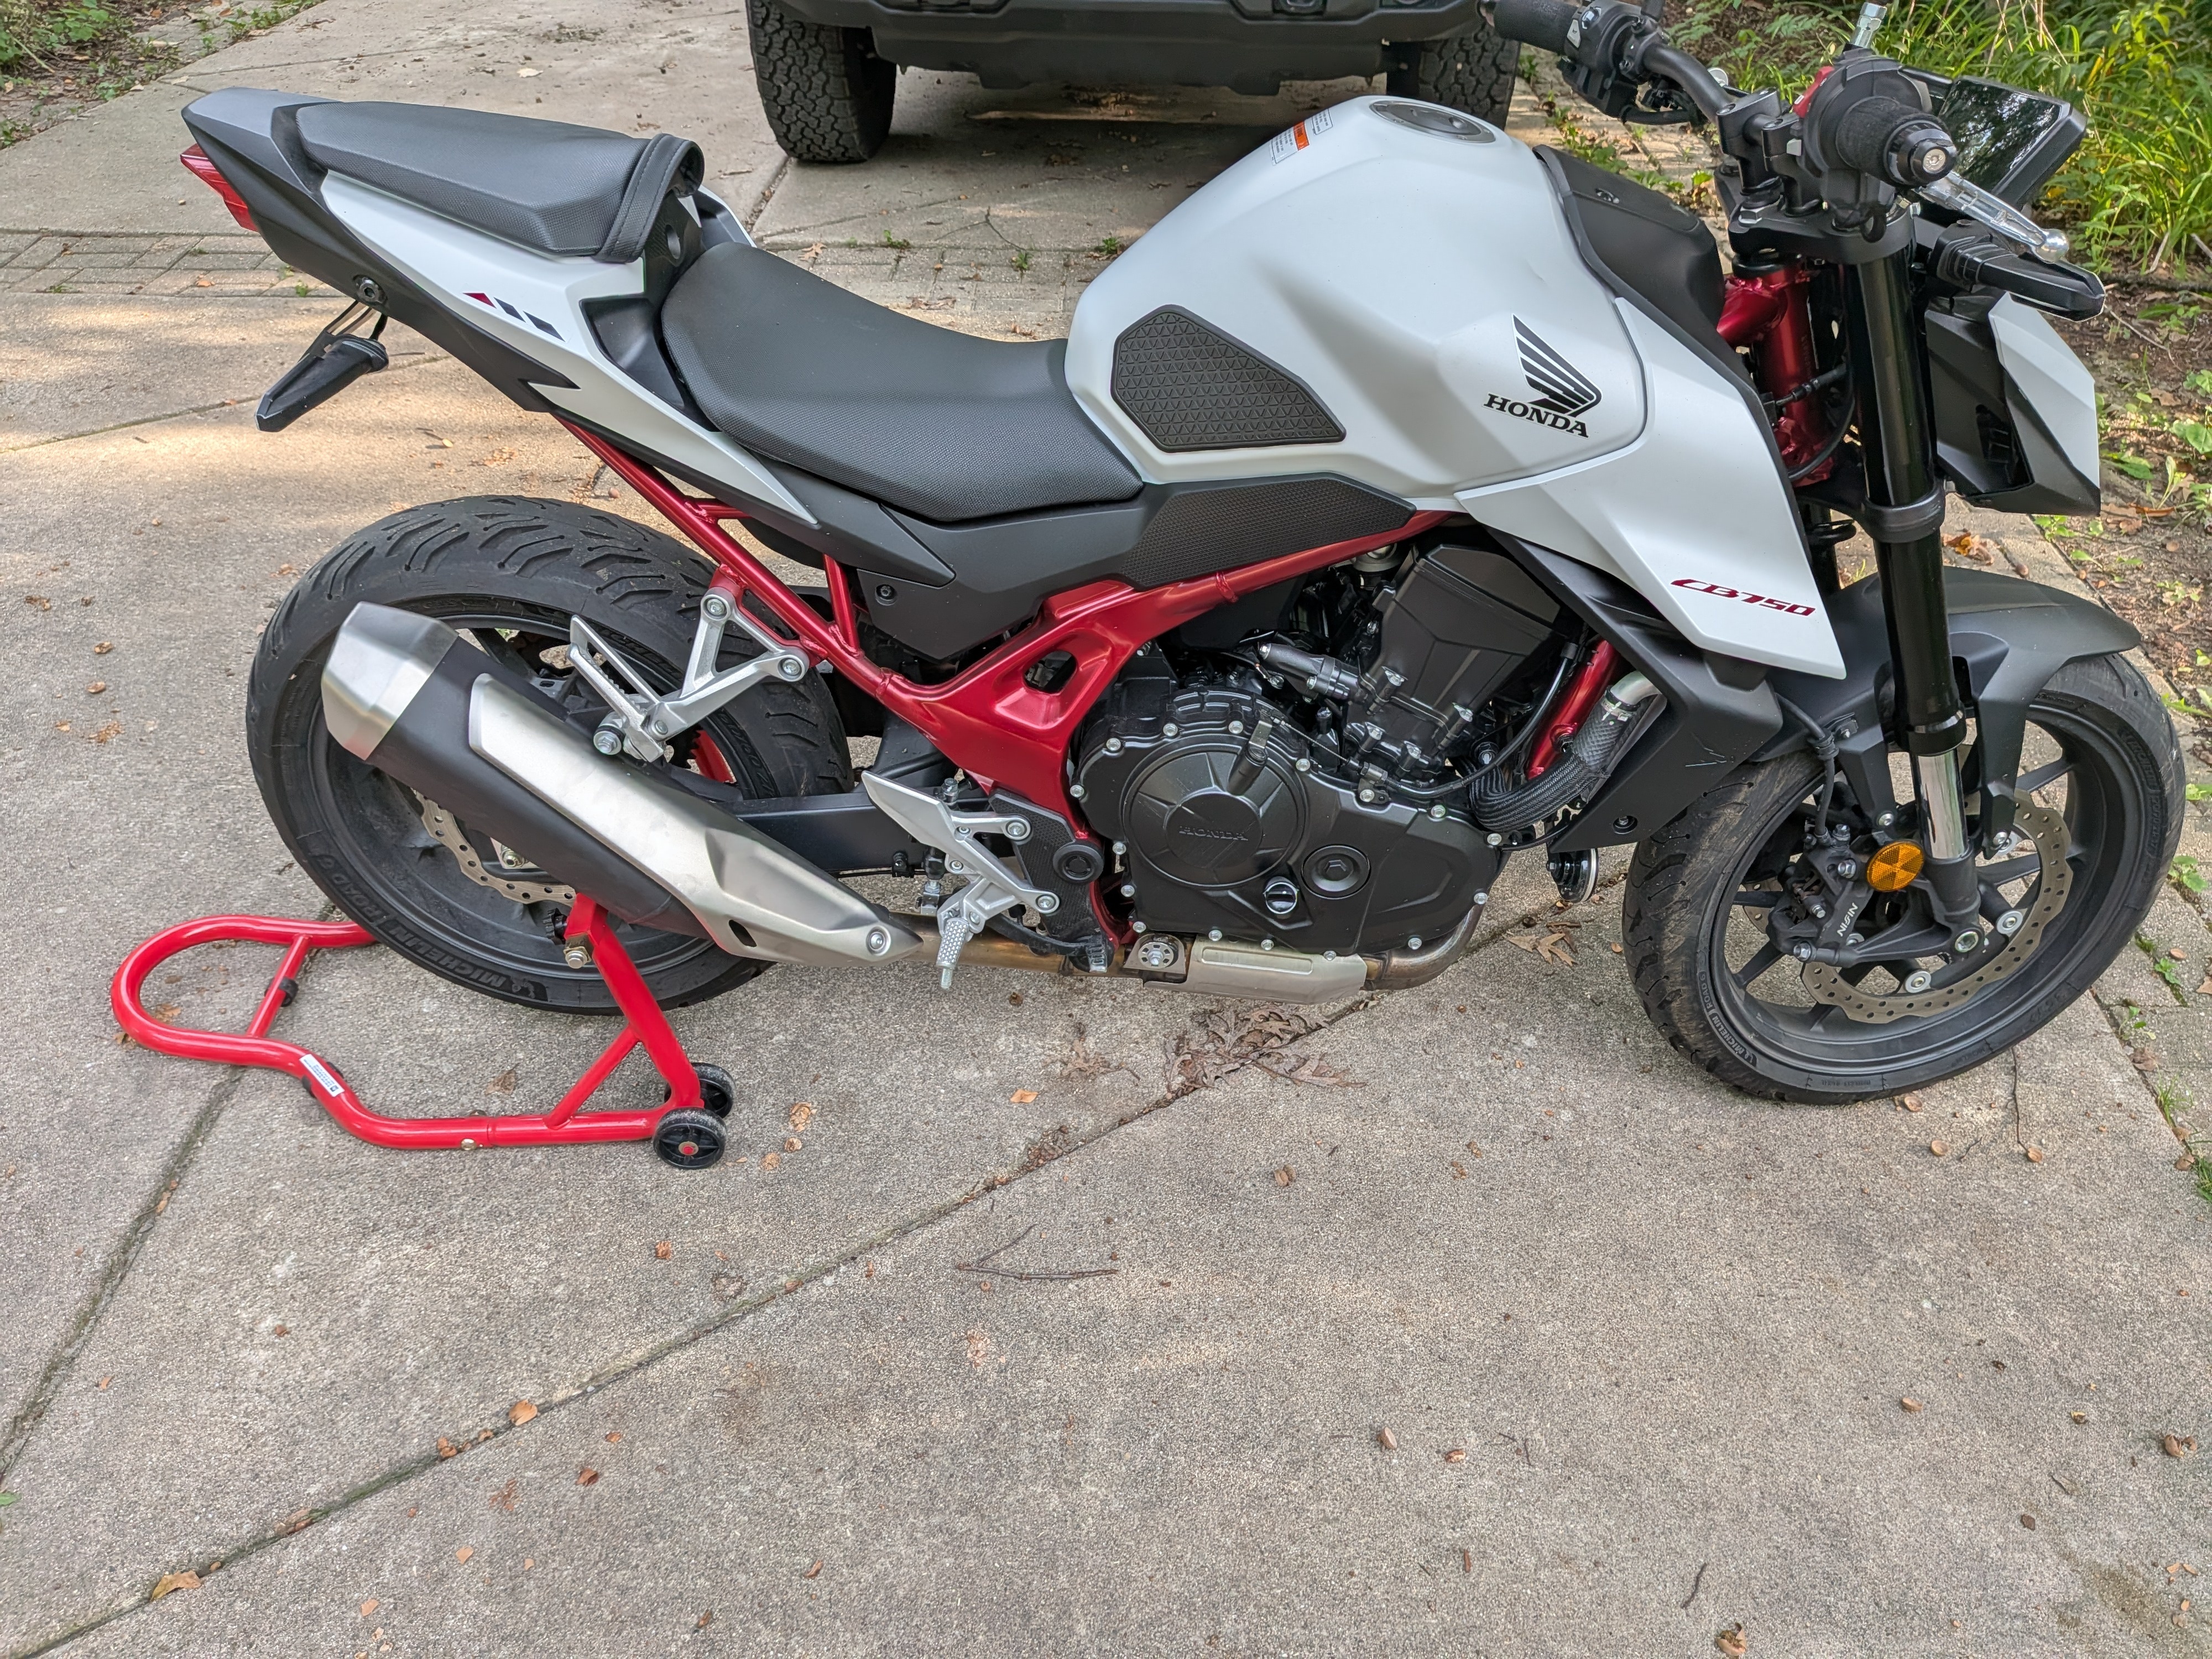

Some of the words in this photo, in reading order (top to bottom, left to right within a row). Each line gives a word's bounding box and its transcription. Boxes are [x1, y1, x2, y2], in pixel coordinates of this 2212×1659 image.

[1483, 393, 1589, 438] HONDA
[1670, 579, 1816, 616] CB750
[1179, 826, 1248, 841] HONDA
[332, 873, 382, 917] ROAD
[1837, 902, 1858, 937] NISSIN
[388, 927, 507, 987] MICHELIN
[1701, 983, 1713, 1009] ROAD
[1712, 1016, 1746, 1055] MICHELIN
